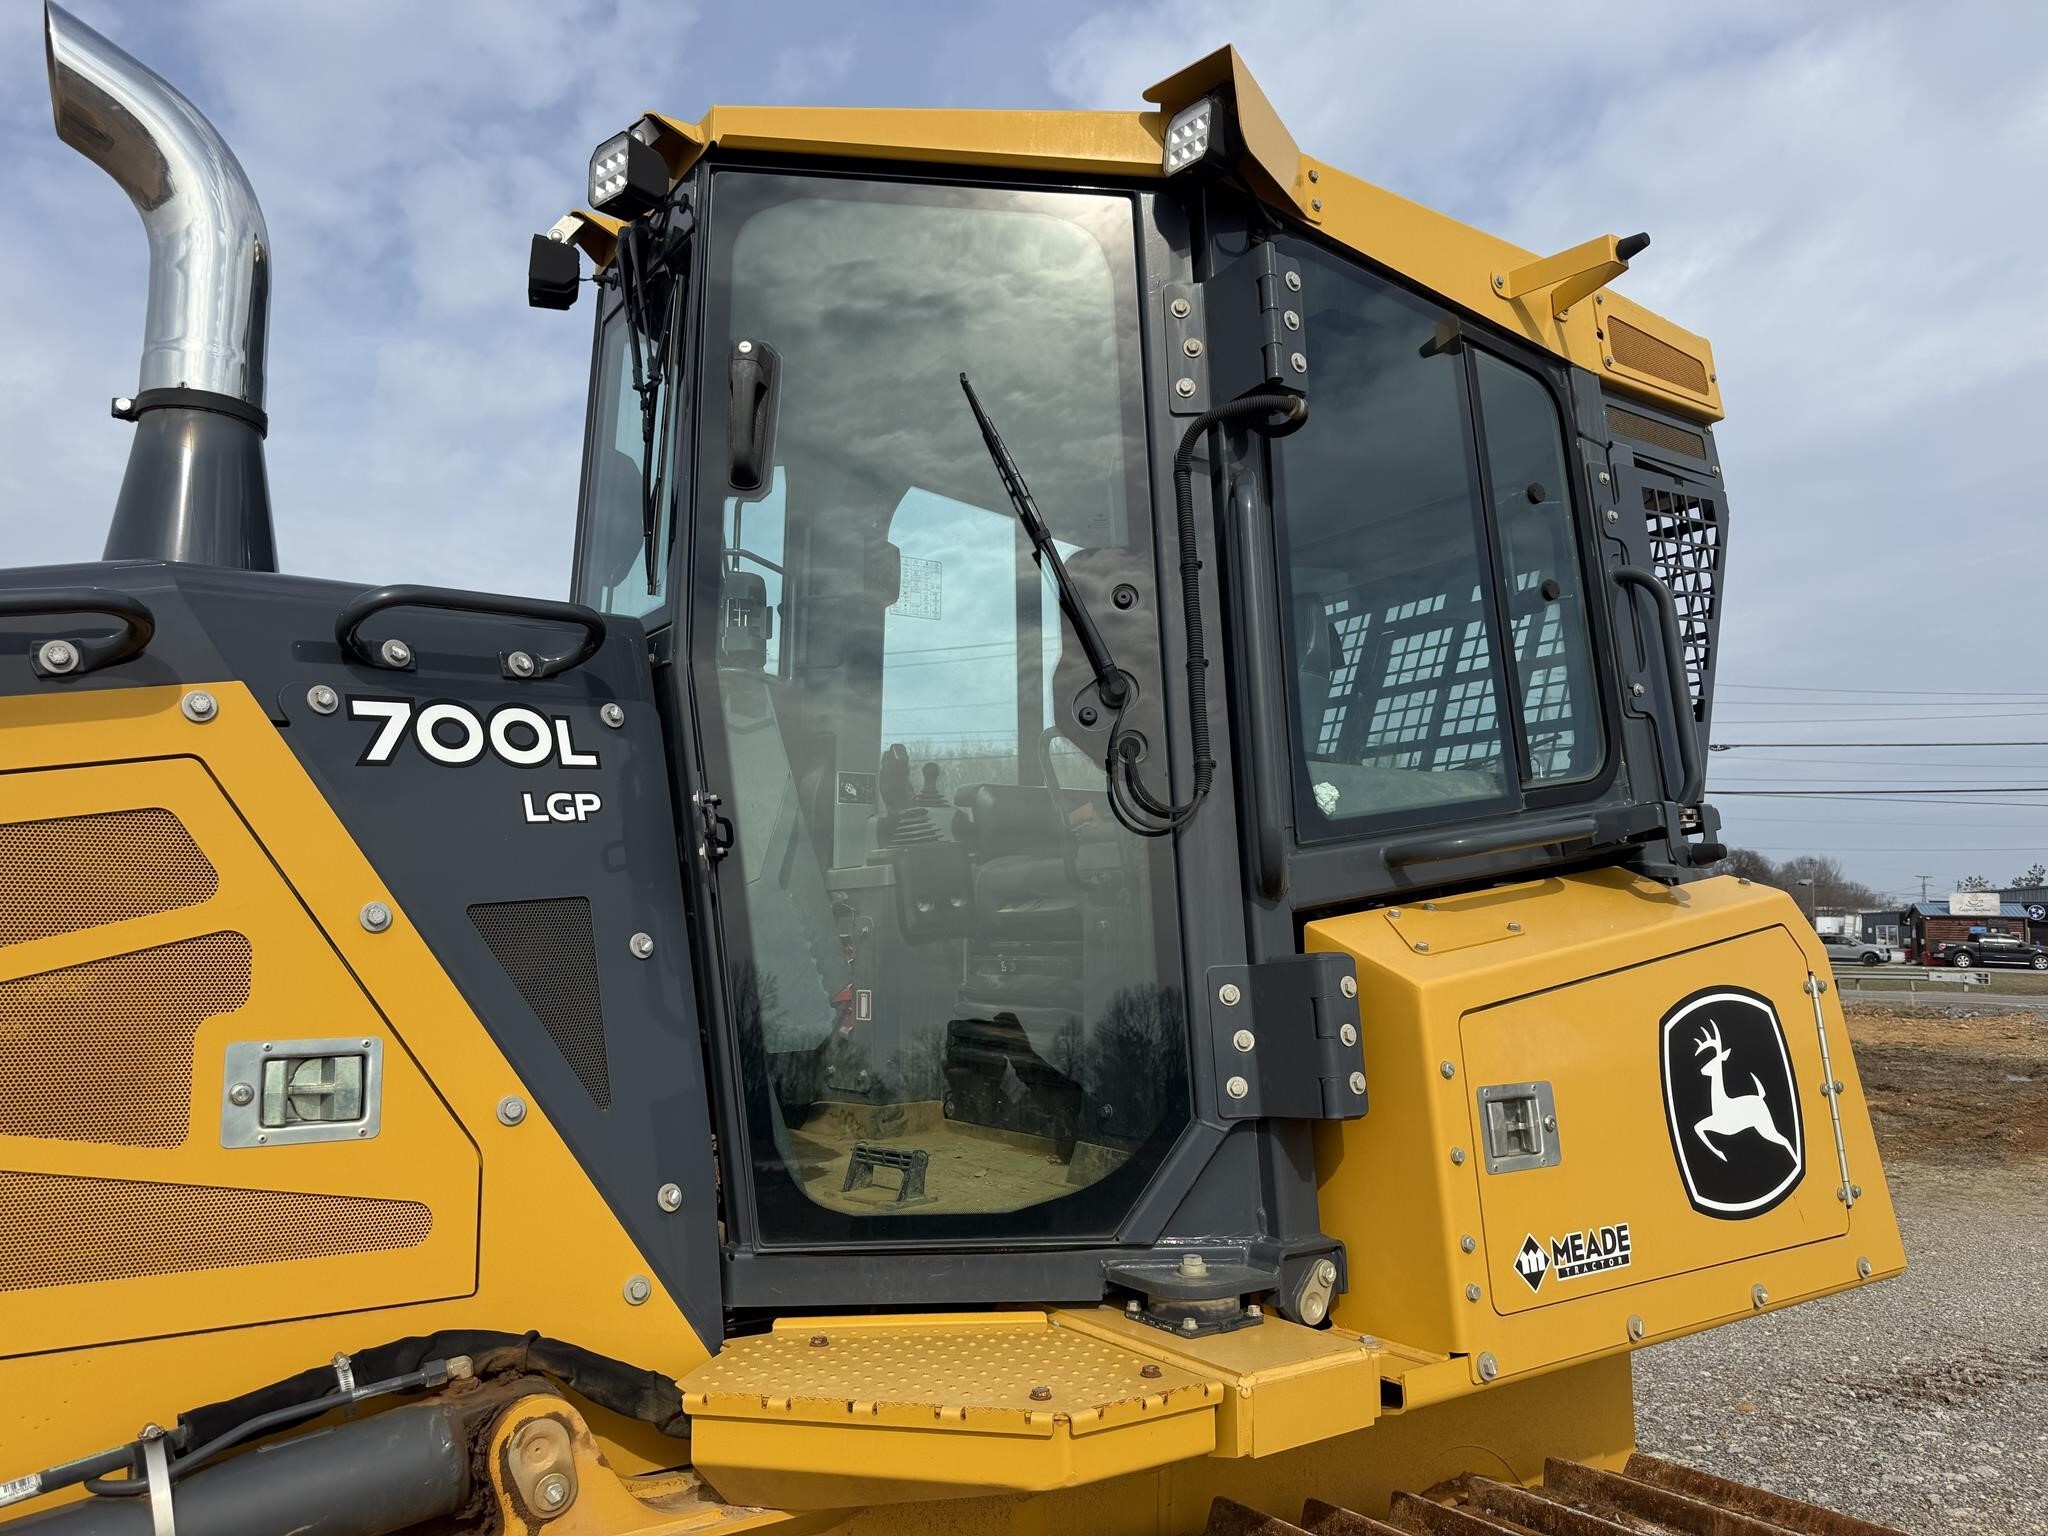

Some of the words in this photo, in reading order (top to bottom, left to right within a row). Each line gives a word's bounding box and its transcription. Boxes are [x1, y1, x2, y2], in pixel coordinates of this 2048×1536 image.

[350, 699, 599, 767] 700L
[521, 792, 602, 823] LGP
[1551, 1224, 1631, 1266] MEADE
[1565, 1256, 1623, 1277] TRACTOR
